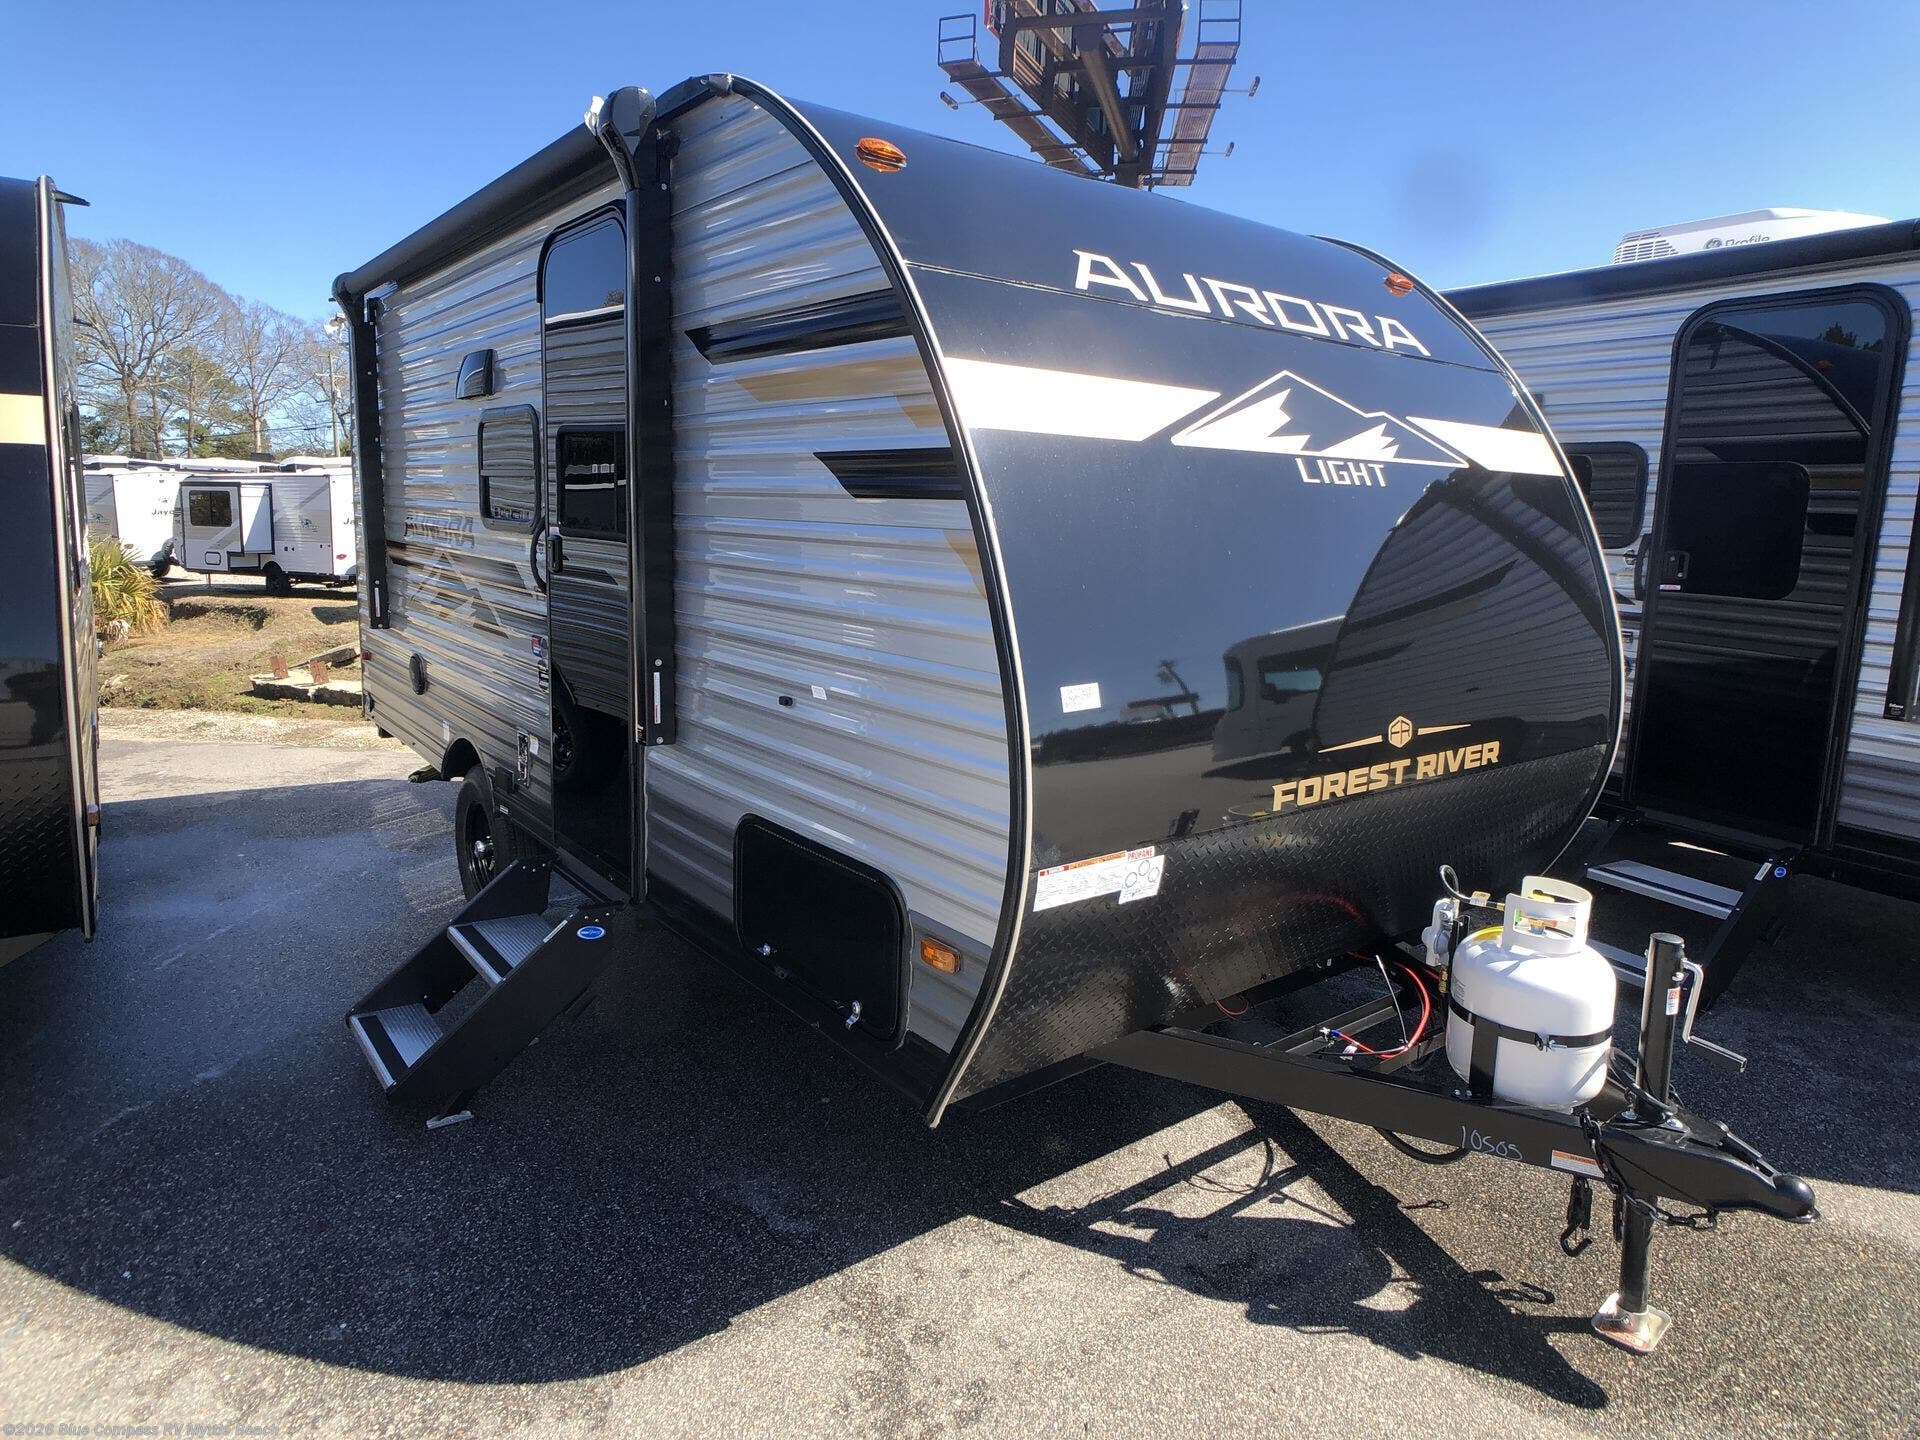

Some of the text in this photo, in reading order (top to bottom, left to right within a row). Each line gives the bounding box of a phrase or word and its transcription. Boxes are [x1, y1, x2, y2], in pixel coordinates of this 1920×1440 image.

[1072, 249, 1432, 356] AURORA
[1295, 457, 1388, 487] LIGHT
[1272, 740, 1500, 812] FOREST RIVER
